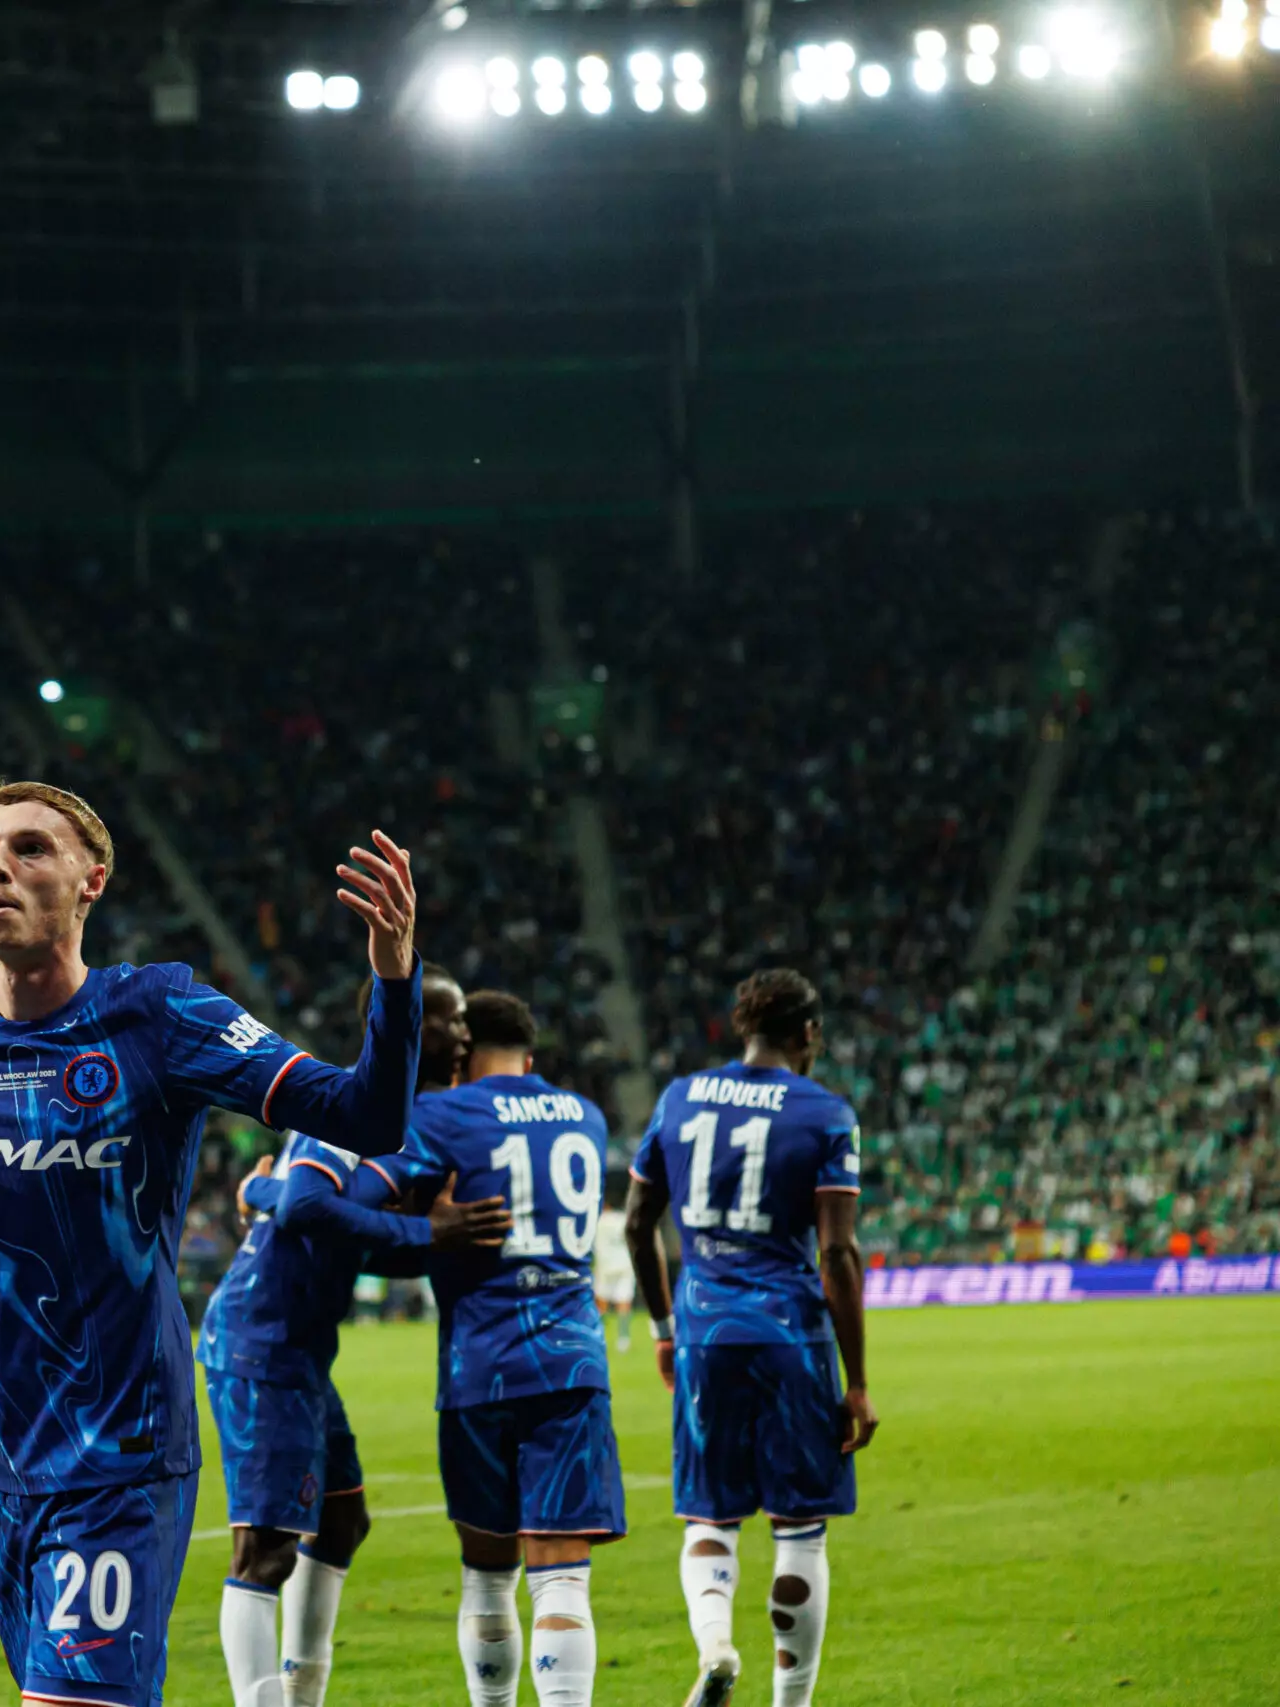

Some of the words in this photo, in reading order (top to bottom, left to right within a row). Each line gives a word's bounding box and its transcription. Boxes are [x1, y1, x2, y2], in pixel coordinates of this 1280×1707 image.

[39, 1069, 57, 1078] 2025
[687, 1076, 788, 1112] MADUEKE
[493, 1094, 584, 1123] SANCHO
[490, 1132, 601, 1259] 19
[679, 1111, 773, 1233] 11
[47, 1549, 132, 1631] 20
